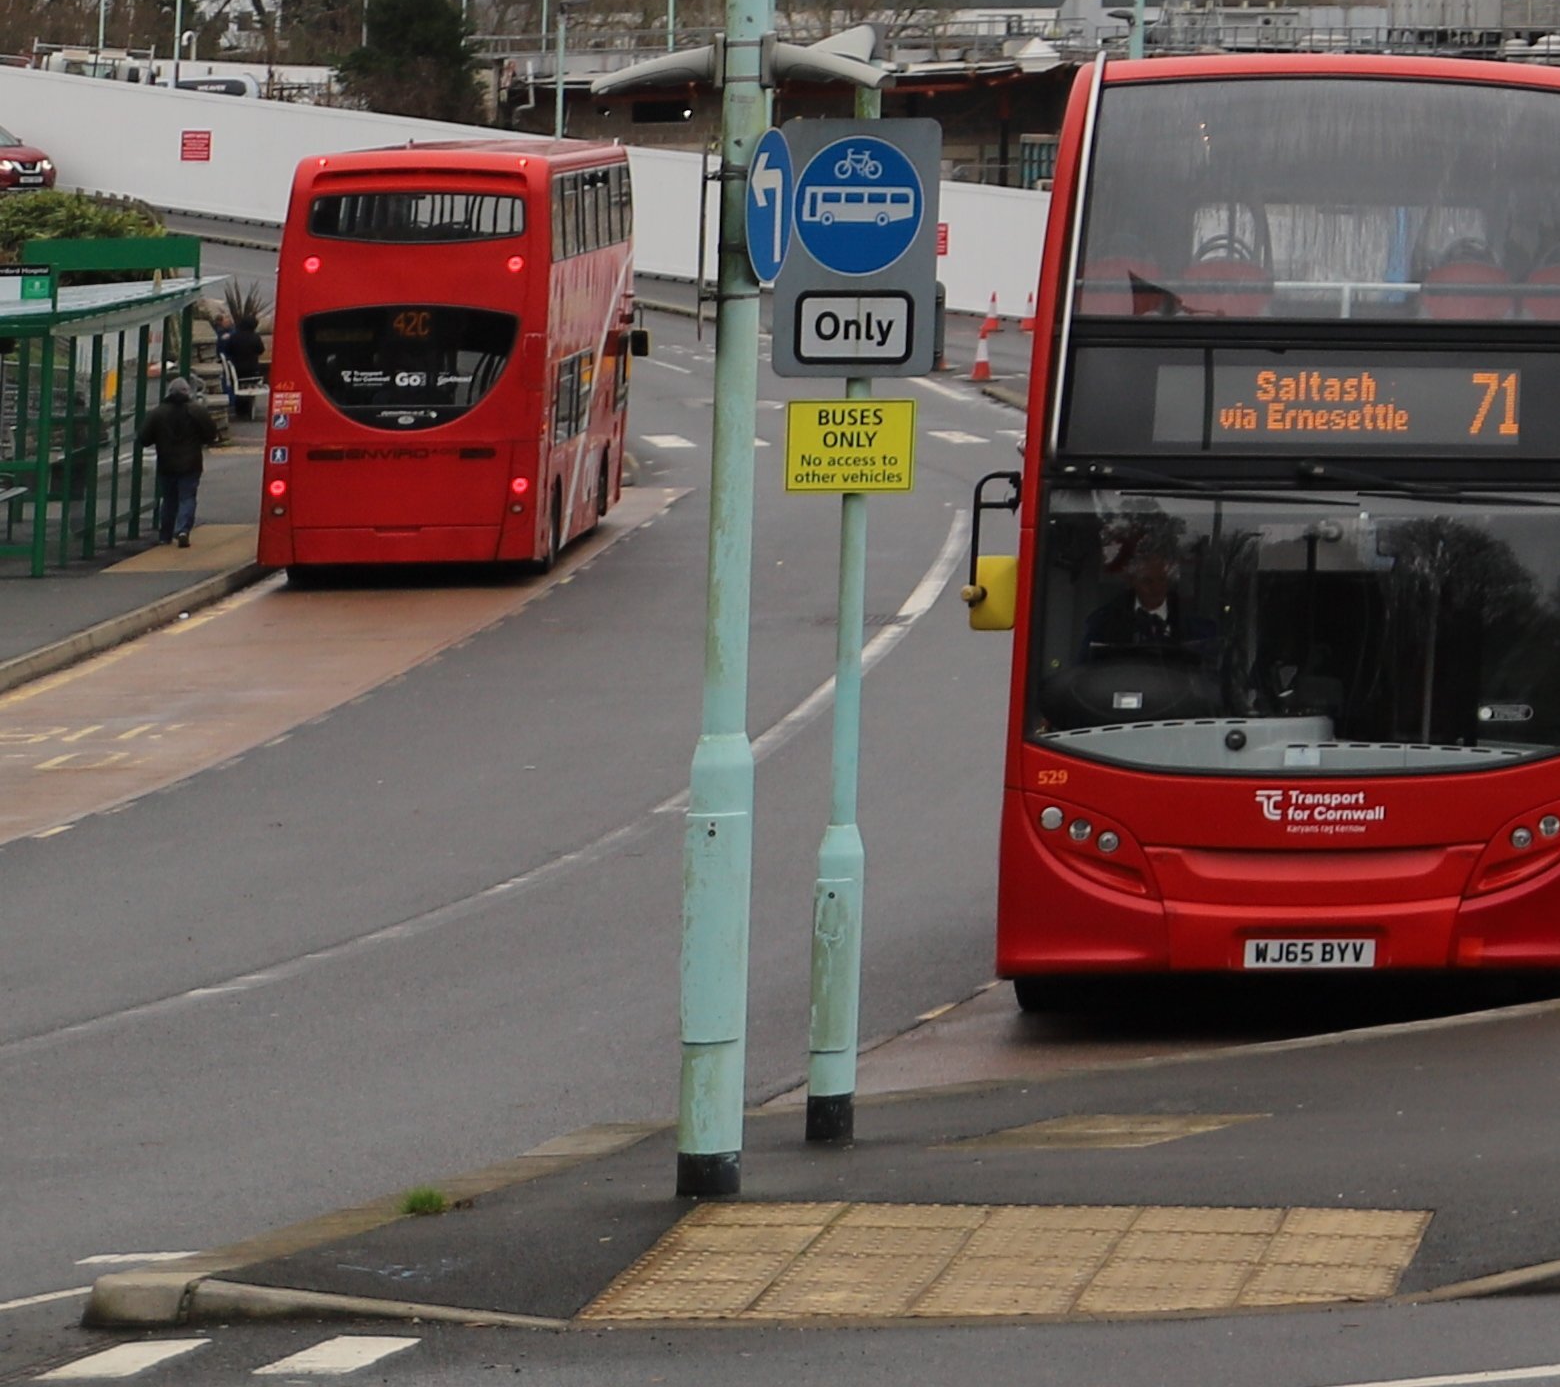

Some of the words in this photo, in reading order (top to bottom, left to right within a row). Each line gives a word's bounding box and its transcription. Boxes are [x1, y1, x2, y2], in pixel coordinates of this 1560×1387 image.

[392, 311, 432, 337] 42C
[814, 310, 895, 346] Only
[1256, 371, 1376, 401] Saltash
[1469, 372, 1519, 435] 71
[818, 408, 883, 426] BUSES
[1219, 403, 1257, 430] via
[1266, 402, 1409, 431] Ernesettle
[823, 430, 878, 448] ONLY
[800, 454, 822, 467] No
[827, 455, 876, 467] access
[882, 454, 898, 466] to
[794, 472, 837, 483] other
[842, 470, 903, 483] vehicles
[1037, 770, 1069, 785] 529
[1288, 790, 1365, 807] Transport
[1287, 805, 1310, 820] for
[1313, 805, 1385, 821] Cornwall
[1334, 824, 1366, 833] Kernow
[1254, 943, 1314, 963] WJ65
[1321, 942, 1366, 962] BYV
